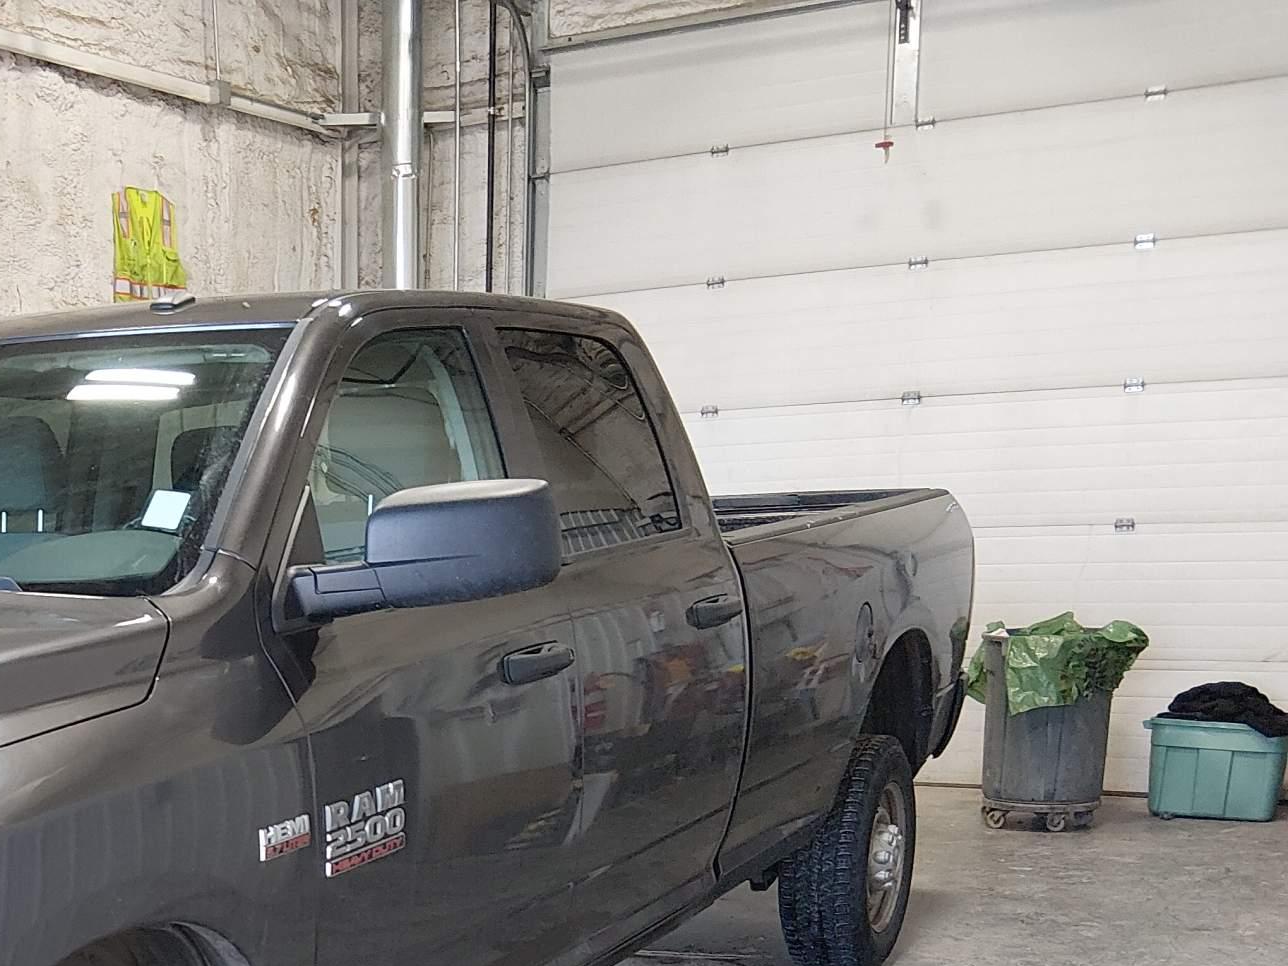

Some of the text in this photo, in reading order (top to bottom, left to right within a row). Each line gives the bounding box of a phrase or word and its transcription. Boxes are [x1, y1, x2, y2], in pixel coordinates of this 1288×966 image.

[259, 814, 310, 847] HEMI
[325, 779, 404, 832] RAM
[326, 807, 405, 860] 2500
